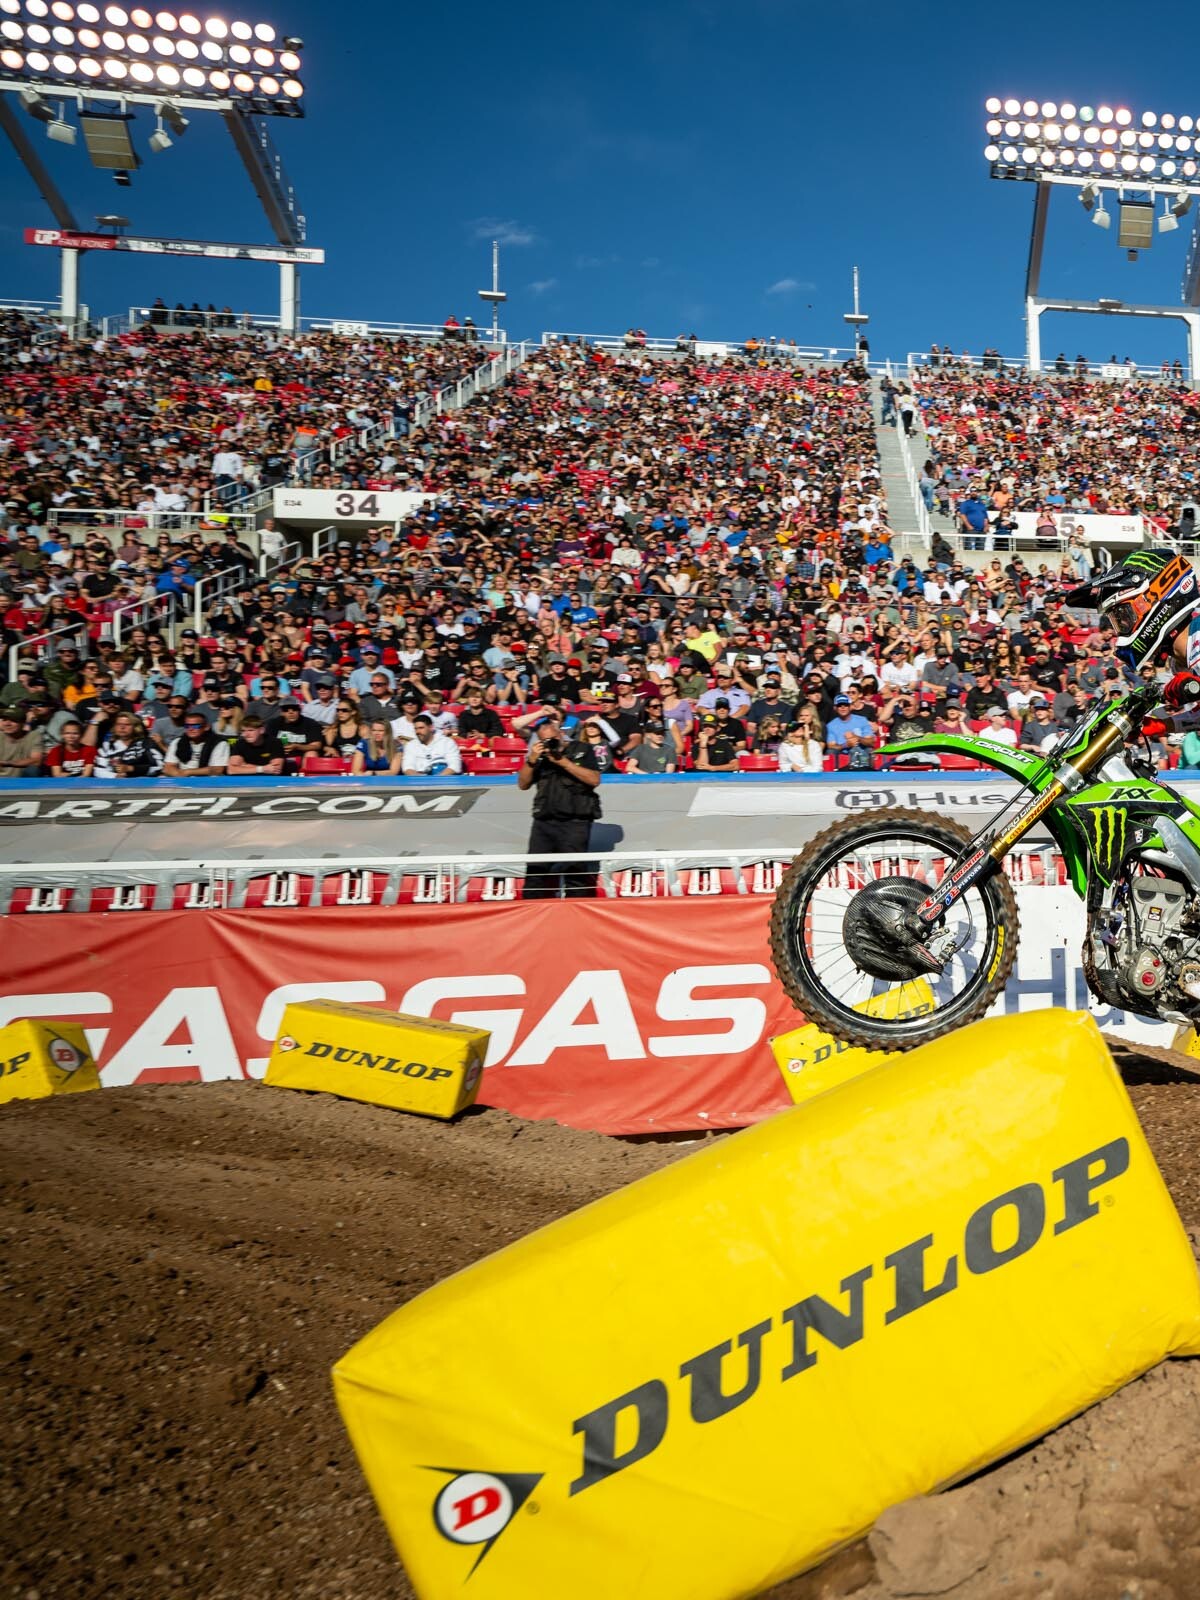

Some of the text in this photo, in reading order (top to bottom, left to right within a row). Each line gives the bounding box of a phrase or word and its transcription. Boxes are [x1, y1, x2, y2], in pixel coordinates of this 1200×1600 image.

[335, 493, 380, 518] 34
[1140, 603, 1172, 640] MONSTER
[974, 741, 1034, 764] CIRCUIT
[1025, 790, 1057, 825] SHOWA
[952, 849, 985, 882] BRAKING
[0, 1052, 32, 1078] P
[304, 1042, 453, 1082] DUNLOP
[569, 1137, 1131, 1497] DUNLOP
[451, 1487, 503, 1532] D
